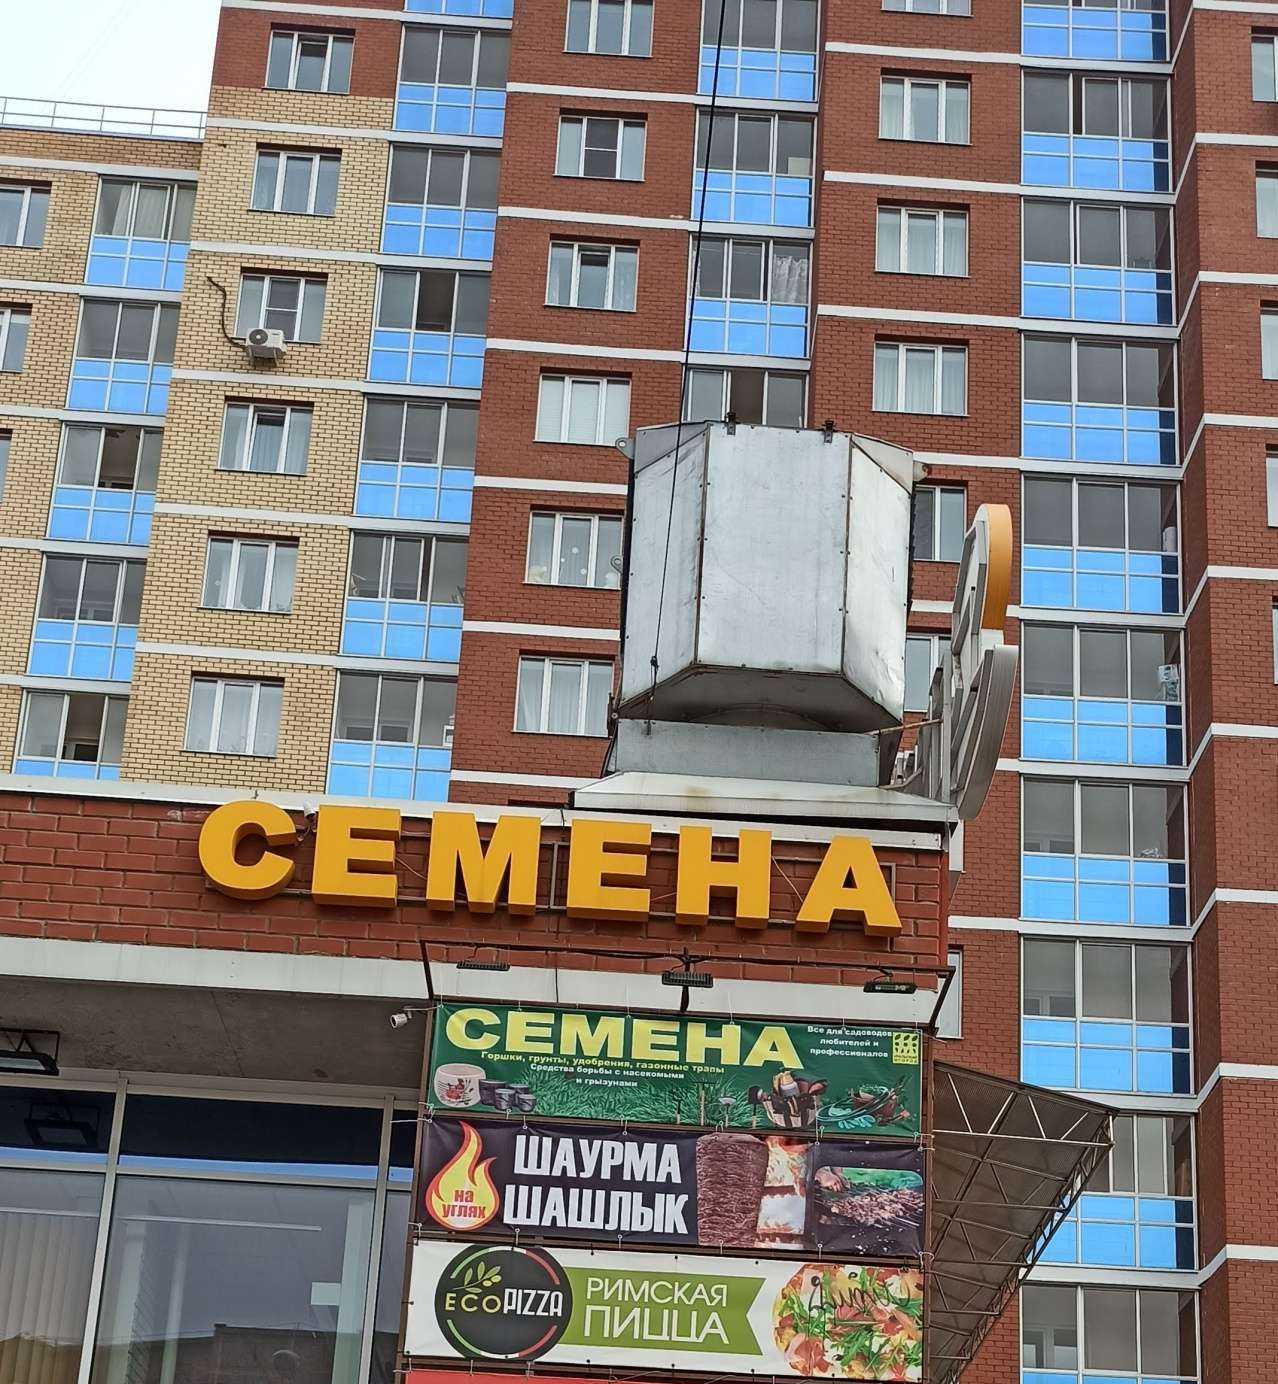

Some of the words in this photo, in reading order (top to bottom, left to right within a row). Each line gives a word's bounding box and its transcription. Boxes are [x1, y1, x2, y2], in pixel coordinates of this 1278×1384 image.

[198, 800, 904, 938] СЕМЕНА
[807, 1025, 824, 1034] Все
[445, 1007, 805, 1070] СЕМЕНА
[819, 1038, 871, 1047] любителей
[481, 1051, 526, 1063] Горшки,
[810, 1047, 889, 1058] профессионалов
[530, 1063, 574, 1073] Средства
[577, 1066, 612, 1076] борьбы
[623, 1070, 685, 1079] насекомыми
[584, 1078, 638, 1087] грызунами
[514, 1134, 682, 1184] ШАУРМА
[454, 1190, 474, 1203] на
[442, 1203, 486, 1219] углях
[503, 1184, 689, 1235] ШАШЛЫК
[586, 1277, 728, 1307] РИМСКАЯ
[584, 1305, 730, 1345] ПИЦЦА
